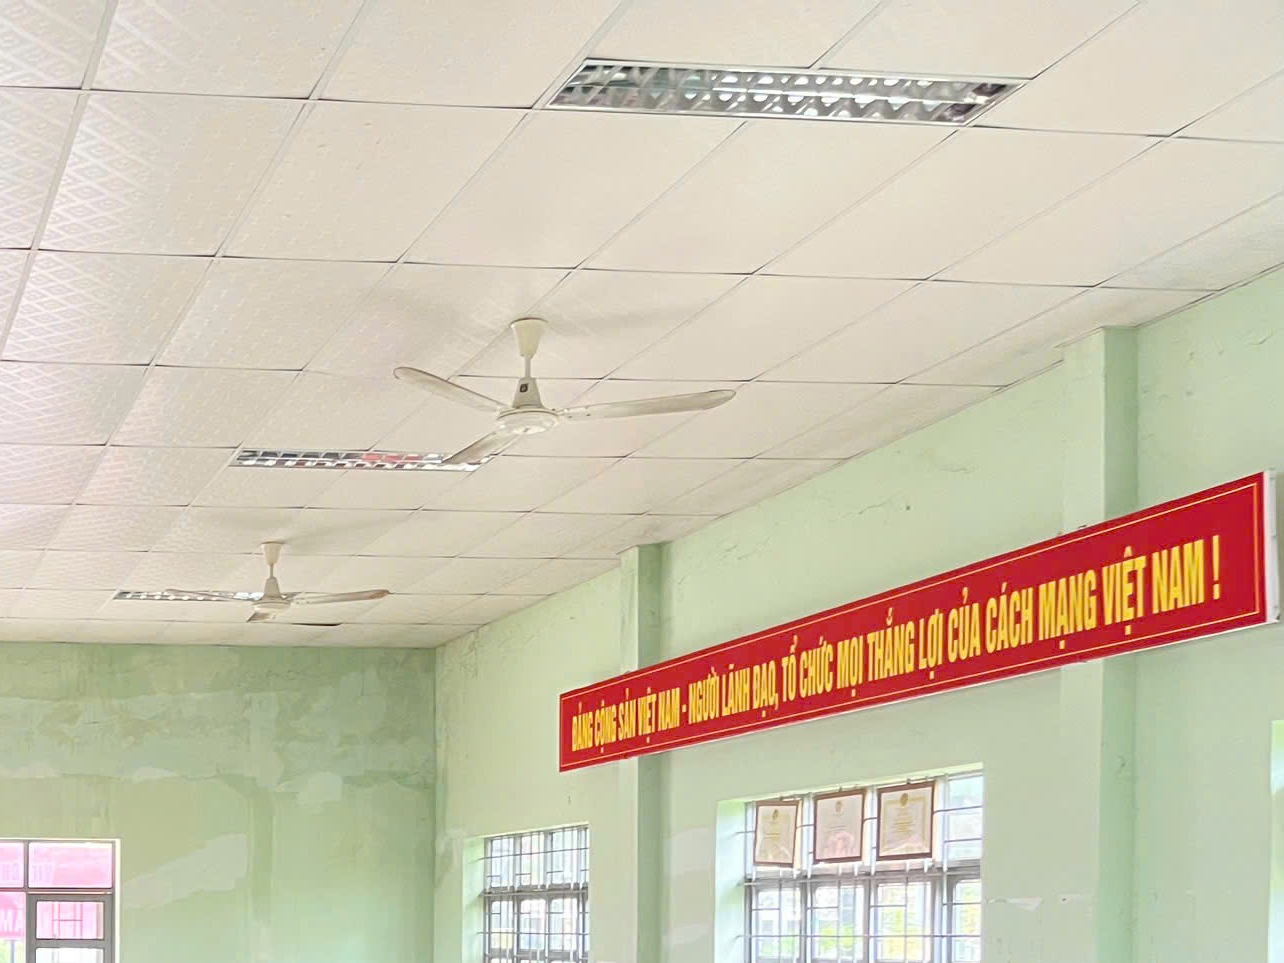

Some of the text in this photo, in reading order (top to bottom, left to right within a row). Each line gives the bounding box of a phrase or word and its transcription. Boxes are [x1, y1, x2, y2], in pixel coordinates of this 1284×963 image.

[571, 701, 594, 752] ĐẢNG
[594, 699, 617, 753] CỘNG
[617, 687, 637, 741] SẢN
[637, 686, 658, 744] VIỆT
[657, 687, 681, 732] NAM
[688, 666, 720, 725] NGƯỜI
[721, 663, 751, 717] LÃNH
[752, 659, 779, 718] ĐẠO,
[781, 634, 798, 703] TỔ
[799, 635, 834, 699] CHỨC
[836, 634, 864, 698] MỌI
[866, 607, 916, 682] THẮNG
[918, 608, 944, 681] LỢI
[947, 586, 981, 664] CỦA
[985, 581, 1034, 654] CÁCH
[1037, 568, 1098, 650] MẠNG
[1101, 545, 1147, 636] VIỆT
[1151, 538, 1205, 615] NAM
